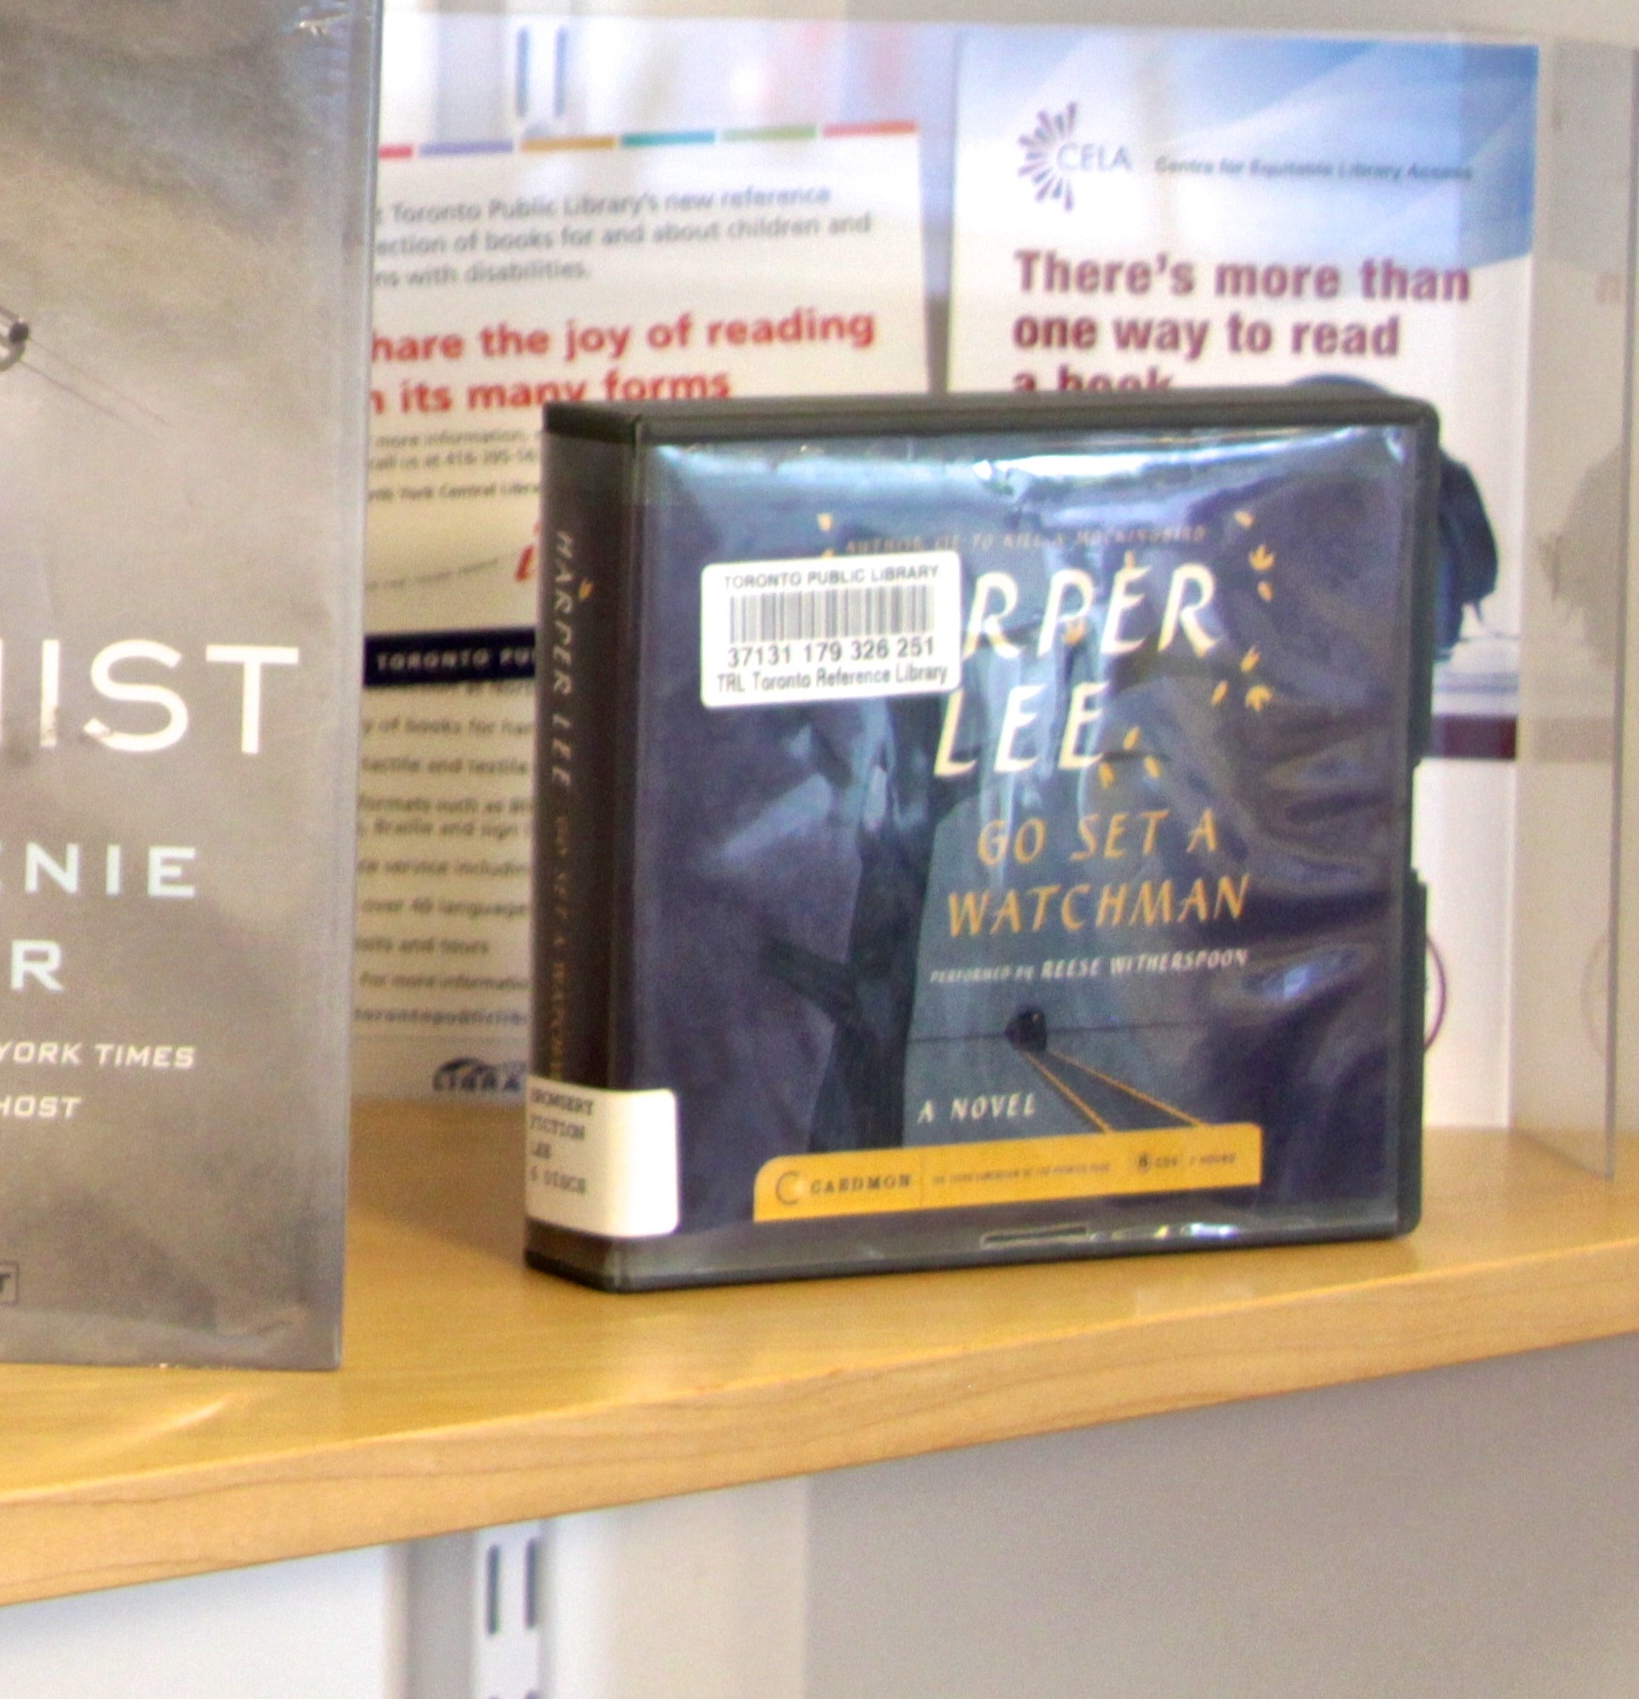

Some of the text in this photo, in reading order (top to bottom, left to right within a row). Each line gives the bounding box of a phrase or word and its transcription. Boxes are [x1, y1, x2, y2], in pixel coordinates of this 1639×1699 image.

[1057, 142, 1132, 173] CELA
[393, 201, 482, 222] Toronto
[452, 210, 872, 253] of books for and and
[1013, 250, 1471, 303] There's more than
[479, 306, 876, 361] the joy of reading
[1012, 312, 1401, 360] one way to read
[400, 367, 731, 415] its many forms
[724, 564, 939, 589] TORONTO PUBLIC LIBRARY
[961, 562, 1222, 661] RPER
[727, 641, 843, 668] 37131 179
[752, 662, 948, 692] Toronto Reference Library
[933, 681, 1110, 778] LEE
[977, 808, 1219, 866] GO SET A
[947, 873, 1251, 938] WATCHMAN
[1041, 949, 1249, 981] REESE WITHERSPOON
[95, 1043, 196, 1070] TIMES
[917, 1093, 1036, 1125] A NOVEL
